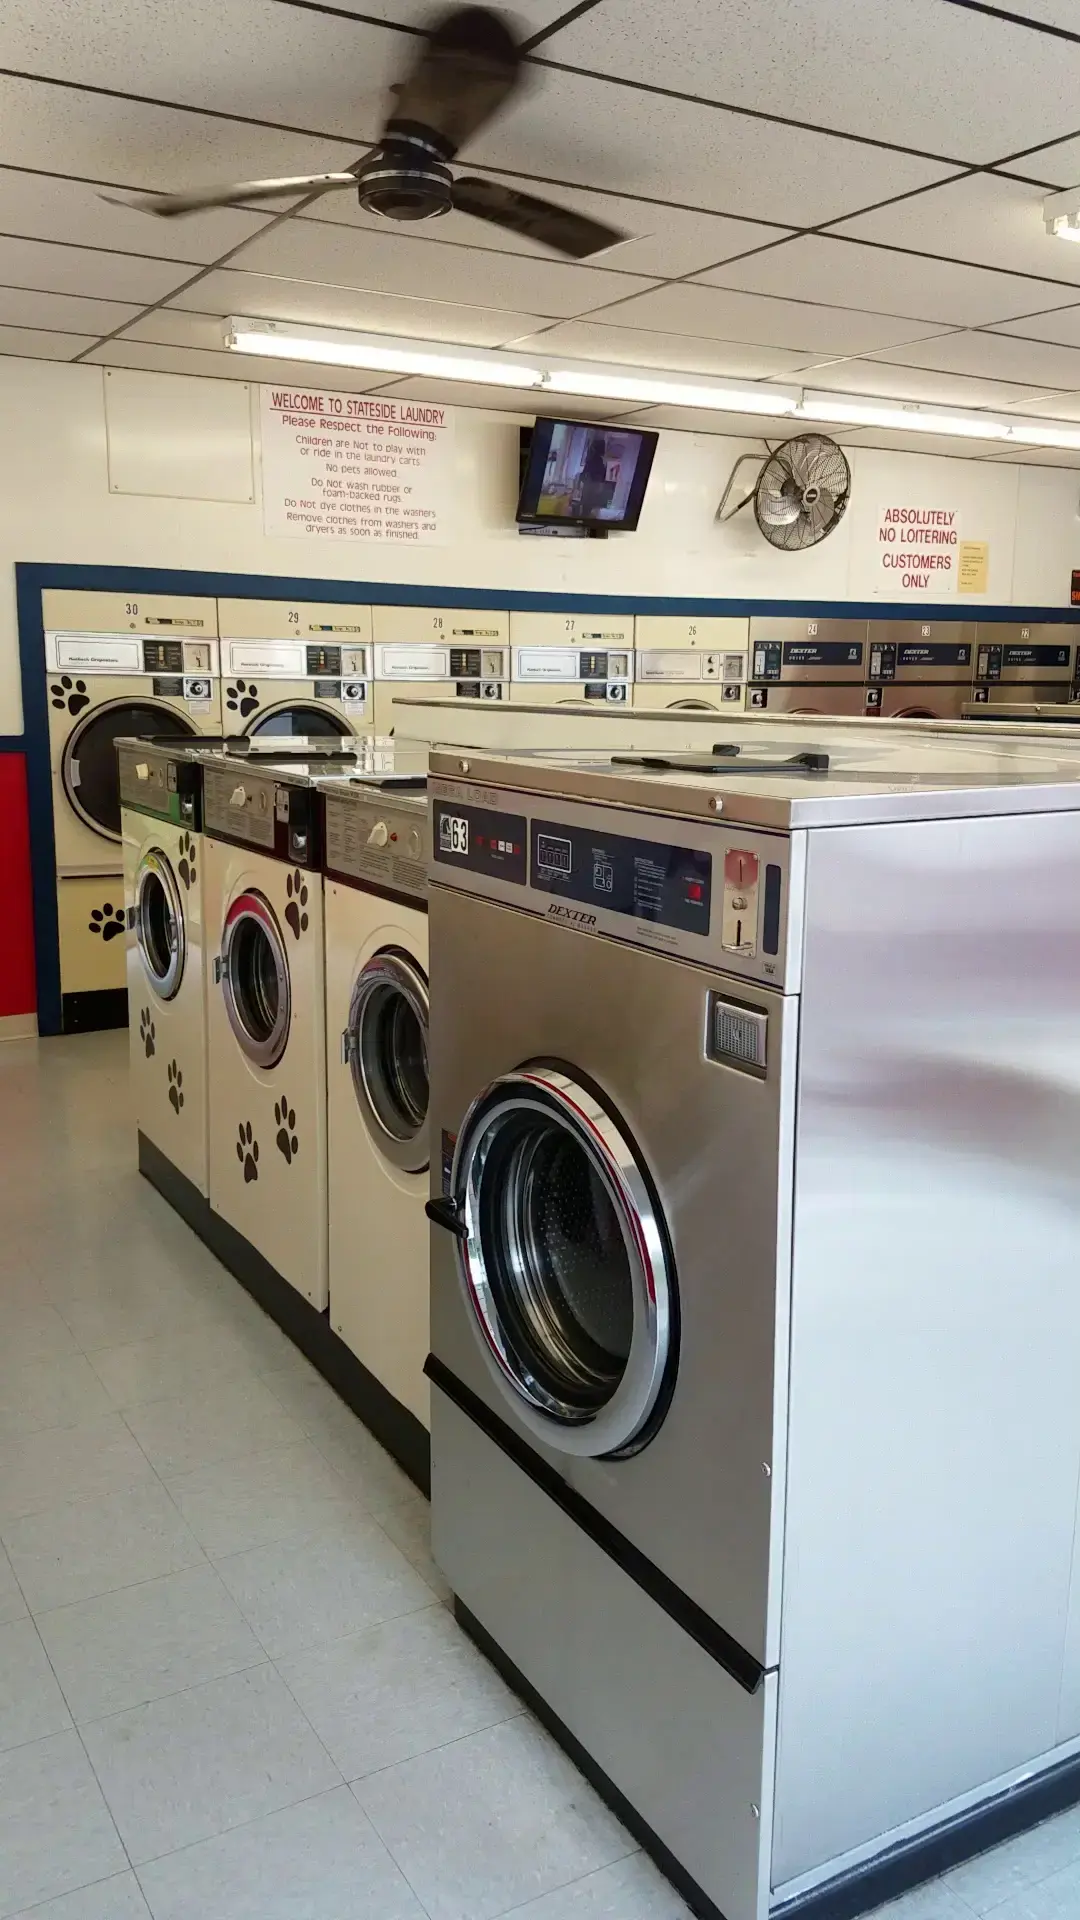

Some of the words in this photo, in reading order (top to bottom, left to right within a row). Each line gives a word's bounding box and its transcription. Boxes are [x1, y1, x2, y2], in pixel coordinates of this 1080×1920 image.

[272, 392, 324, 411] WELCOME
[328, 398, 342, 413] TO
[347, 400, 396, 419] STATESIDE
[400, 406, 444, 424] LAUNDRY
[282, 415, 316, 428] Please
[320, 419, 361, 433] Respect
[366, 424, 384, 434] the
[388, 426, 437, 441] Following:
[296, 435, 332, 446] Children
[336, 439, 349, 448] are
[353, 441, 368, 450] Not
[373, 443, 382, 452] to
[386, 444, 402, 454] play
[406, 446, 425, 456] with
[313, 448, 330, 458] ride
[335, 450, 342, 459] in
[346, 451, 360, 460] the
[364, 453, 395, 465] laundry
[326, 464, 337, 472] No
[341, 465, 360, 475] pets
[311, 478, 323, 487] Do
[326, 480, 342, 489] Not
[346, 482, 368, 490] wash
[372, 484, 400, 493] rubber
[404, 486, 412, 494] or
[323, 489, 379, 501] foam-backed
[284, 498, 296, 507] Do
[300, 500, 316, 509] Not
[320, 501, 336, 511] dye
[340, 503, 370, 513] clothes
[374, 505, 382, 514] in
[385, 506, 399, 515] the
[403, 508, 436, 518] washers
[286, 512, 322, 523] Remove
[326, 516, 356, 525] clothes
[360, 518, 382, 527] from
[385, 520, 418, 530] washers
[884, 508, 955, 526] ABSOLUTELY
[306, 524, 334, 534] dryers
[338, 527, 346, 535] as
[350, 528, 370, 536] soon
[879, 527, 896, 542] NO
[900, 529, 957, 545] LOITERING
[882, 553, 951, 570] CUSTOMERS
[902, 574, 930, 588] ONLY
[126, 603, 138, 615] 30
[288, 611, 299, 623] 29
[433, 618, 443, 629] 28
[565, 621, 575, 631] 27
[688, 626, 697, 636] 26
[808, 624, 816, 634] 24
[922, 626, 929, 635] 23
[452, 819, 467, 852] 63
[548, 904, 597, 926] DEXTER
